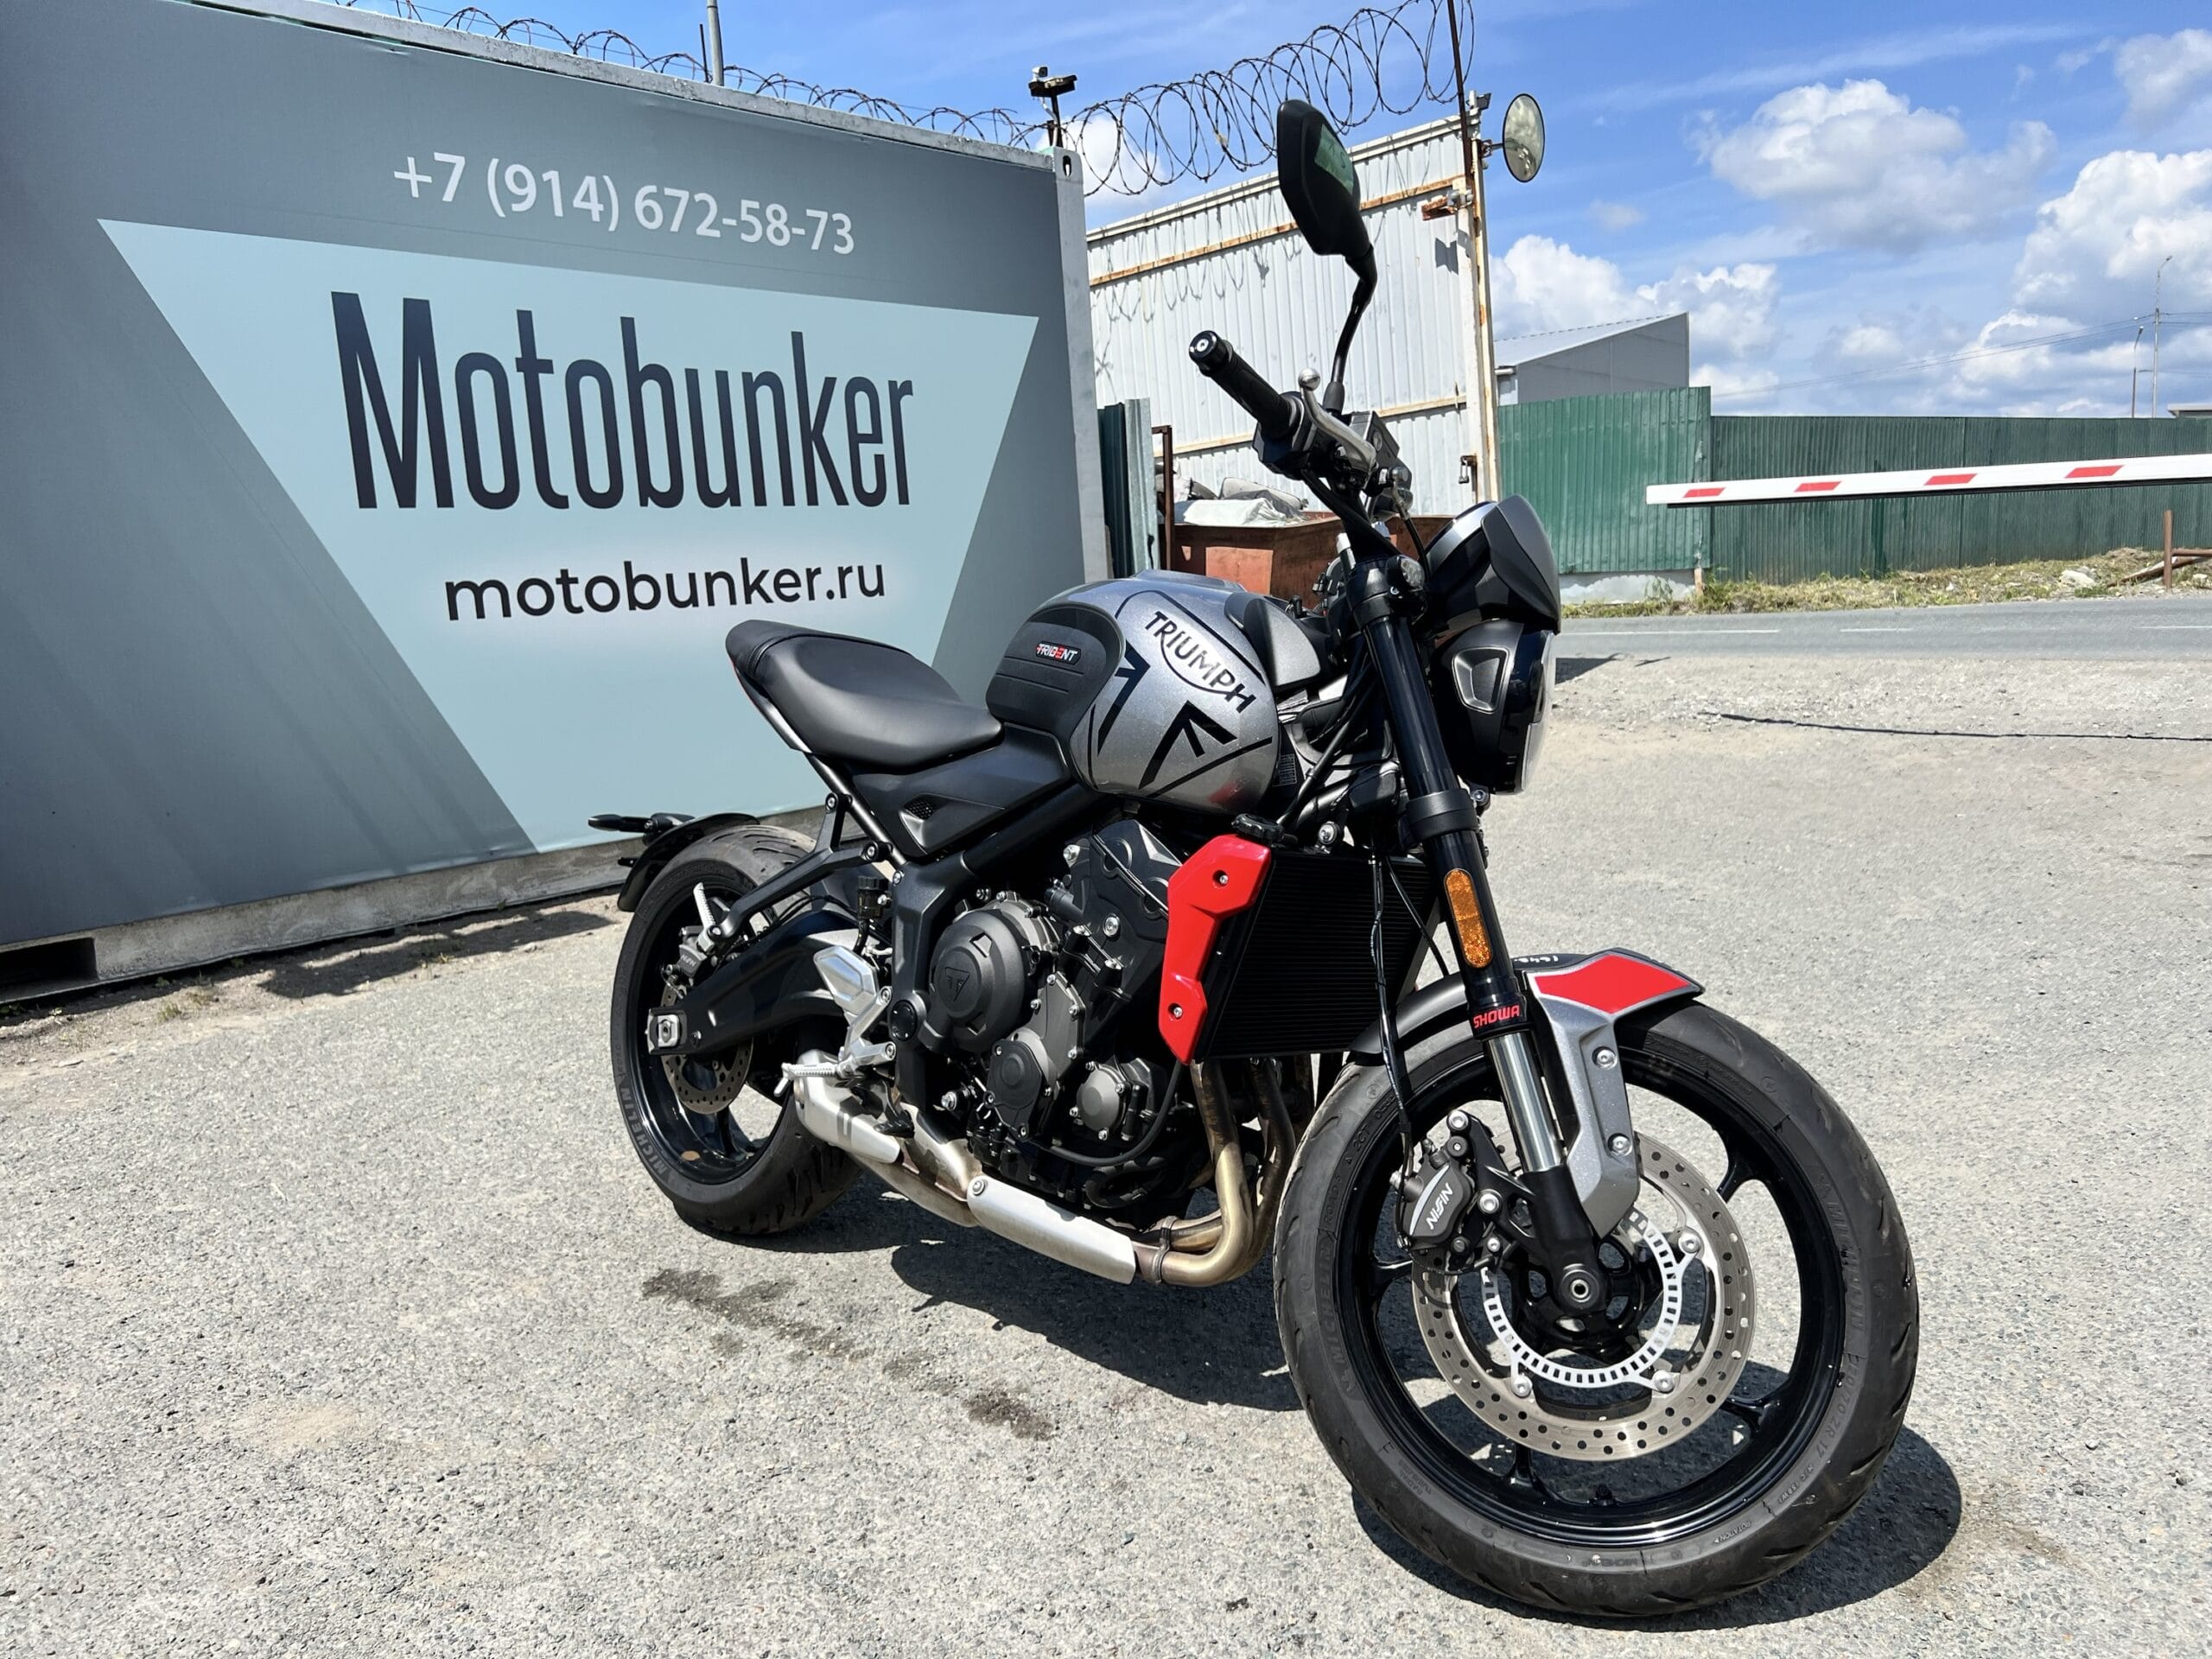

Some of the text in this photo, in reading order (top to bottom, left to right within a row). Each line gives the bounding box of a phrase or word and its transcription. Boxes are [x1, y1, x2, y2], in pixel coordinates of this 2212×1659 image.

[394, 150, 855, 255] +7 (914) 672-58-73
[331, 291, 913, 510] Motobunker
[445, 557, 886, 621] motobunker.ru
[1037, 643, 1078, 664] TRIDENT
[1144, 611, 1257, 714] TRIUMPH
[1472, 1004, 1521, 1030] SHOWA
[620, 1087, 669, 1175] MICHELIN
